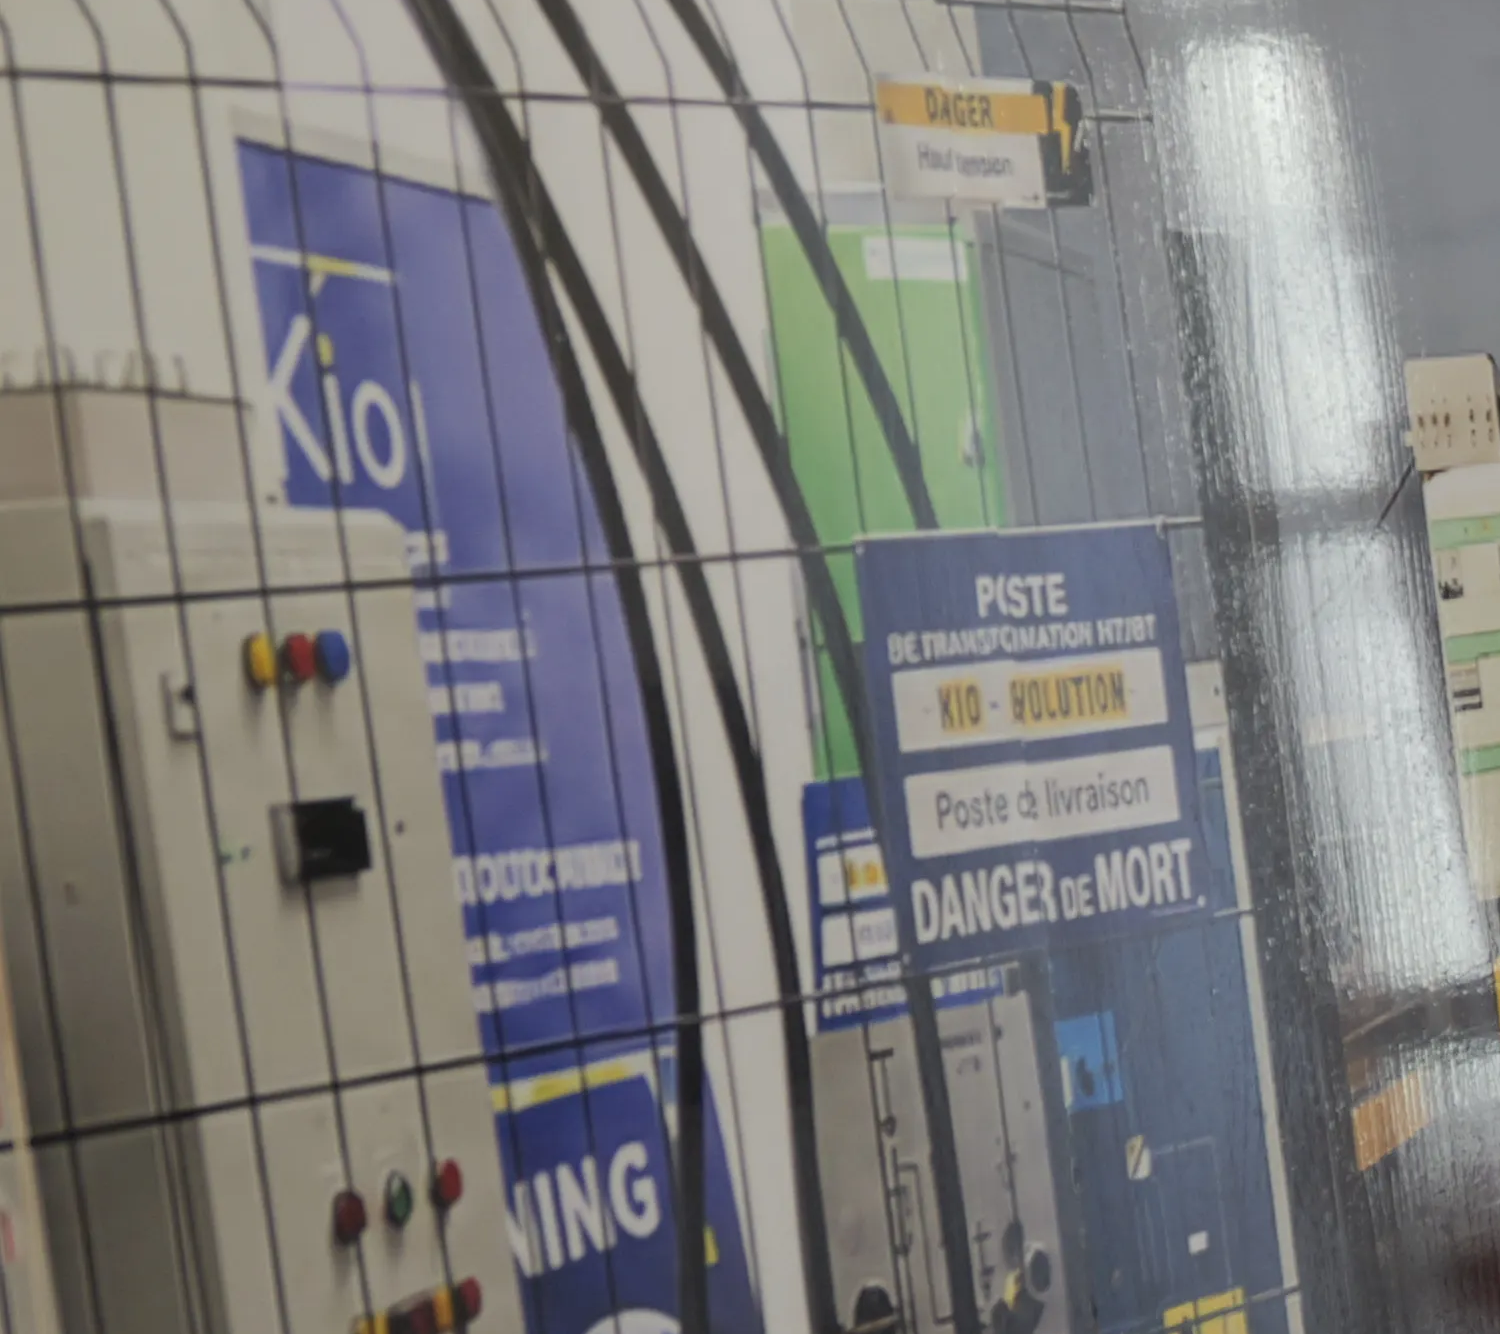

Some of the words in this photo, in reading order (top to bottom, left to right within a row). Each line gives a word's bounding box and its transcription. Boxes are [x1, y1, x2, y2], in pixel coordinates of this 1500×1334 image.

[938, 683, 982, 732] KIO
[935, 789, 1009, 831] Poste
[1044, 771, 1150, 820] livraison
[911, 860, 1058, 946] DANGER
[1059, 874, 1096, 921] DE
[1095, 837, 1192, 914] MORT
